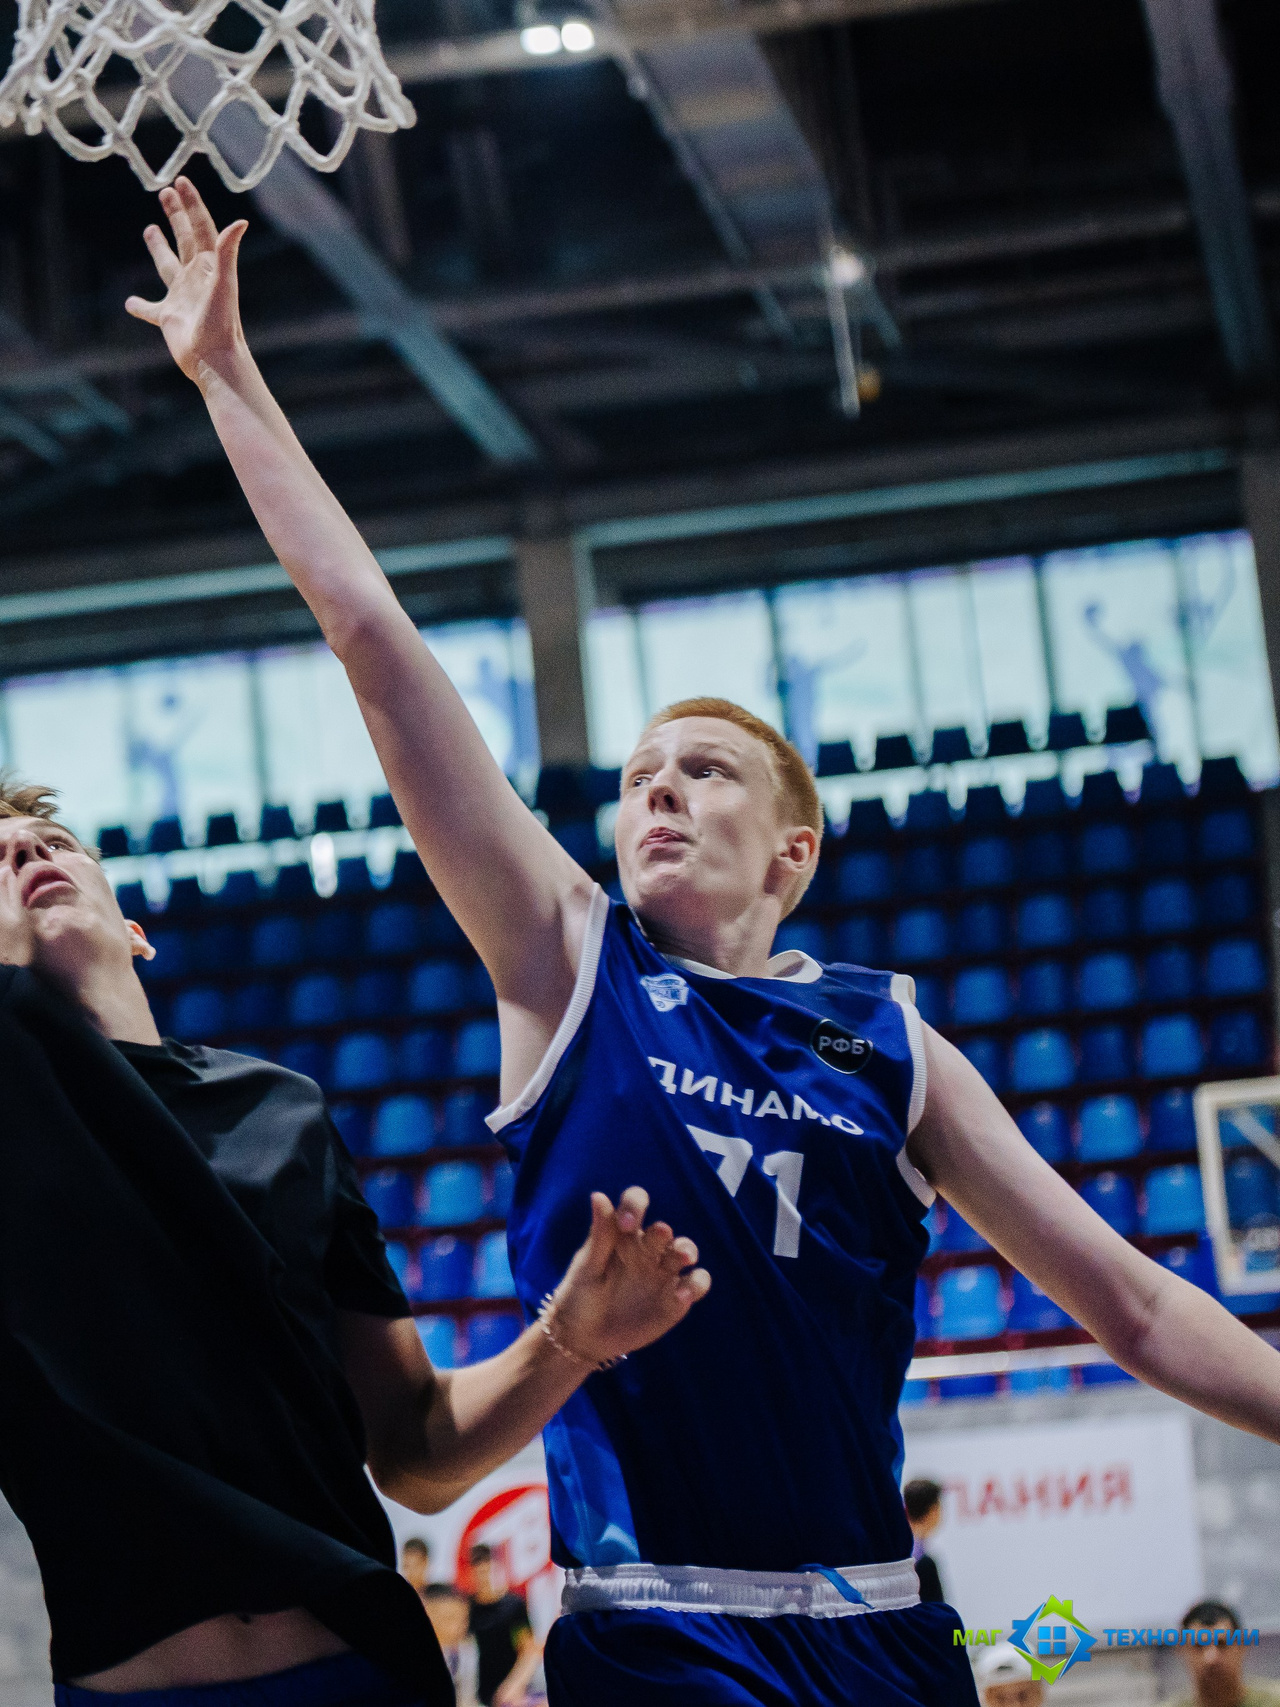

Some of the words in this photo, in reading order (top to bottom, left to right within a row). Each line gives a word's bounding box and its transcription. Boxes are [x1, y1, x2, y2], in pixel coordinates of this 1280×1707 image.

[819, 1035, 865, 1055] РФБ
[648, 1056, 865, 1136] ДИНАМО
[686, 1124, 804, 1259] 71
